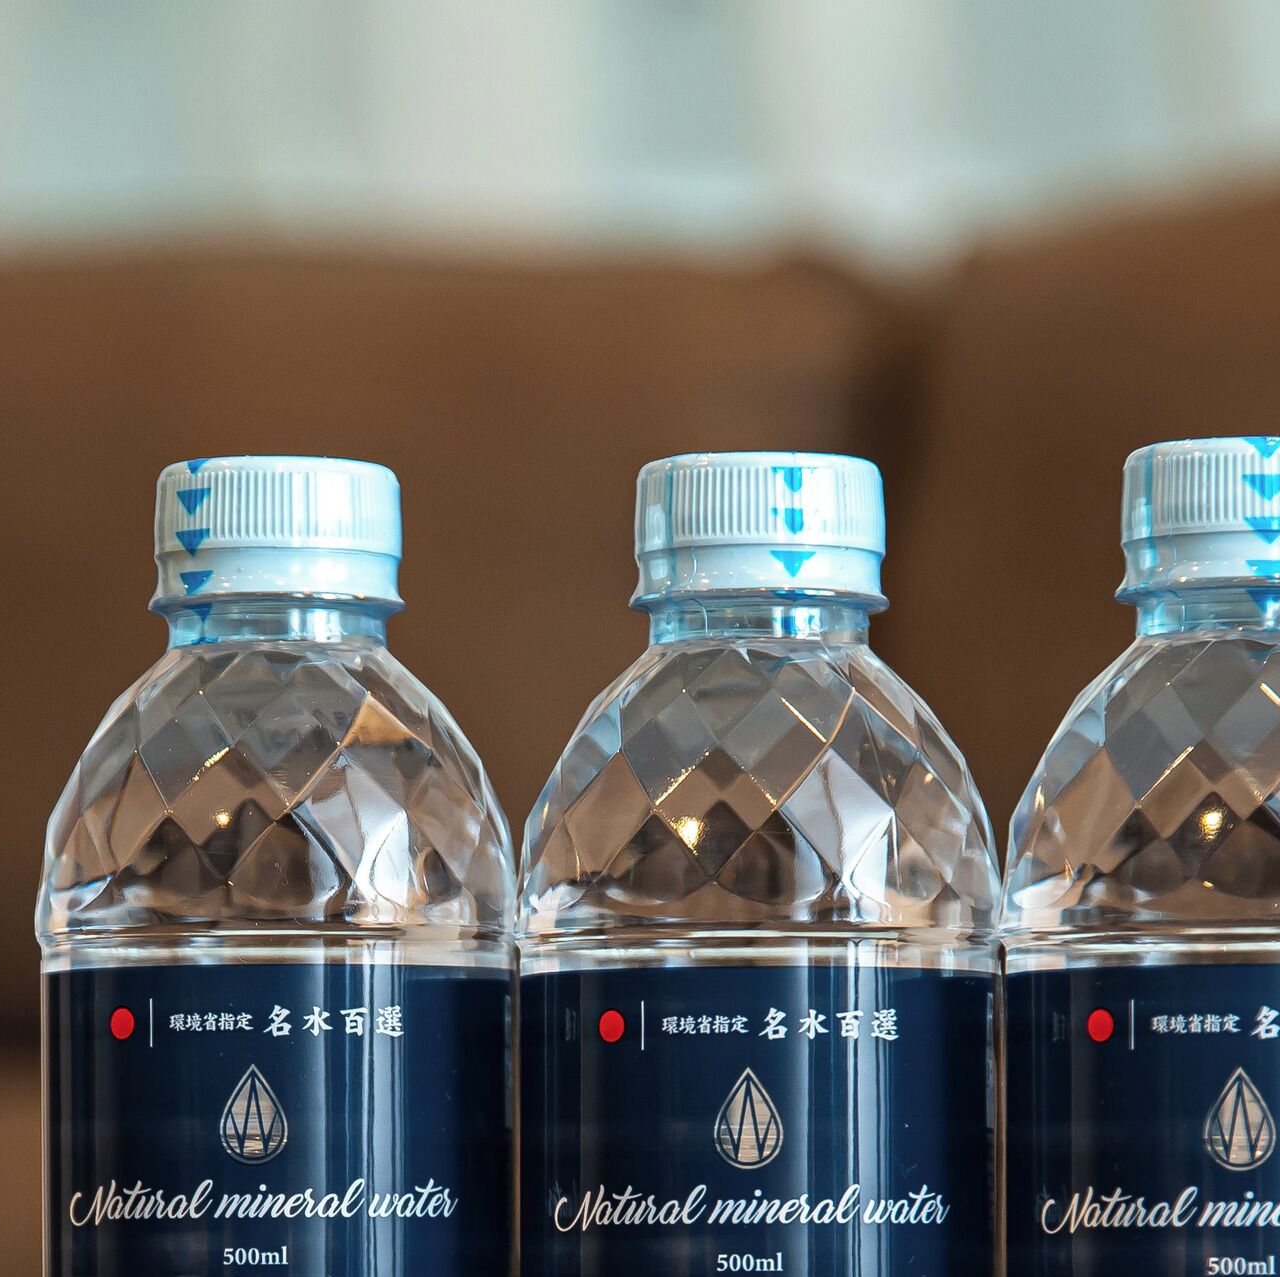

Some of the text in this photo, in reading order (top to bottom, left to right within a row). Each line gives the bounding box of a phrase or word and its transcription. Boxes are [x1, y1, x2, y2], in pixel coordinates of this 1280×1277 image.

[169, 1005, 406, 1038] 環境省指定 名水百選
[661, 1008, 900, 1041] 環境省指定 名水百選
[1151, 1013, 1241, 1034] 環境省指定
[69, 1178, 458, 1227] Natural mineral water
[554, 1184, 950, 1232] Natural mineral water
[1041, 1186, 1198, 1234] Natural
[222, 1246, 289, 1266] 500ml
[716, 1253, 784, 1272] 500ml
[1207, 1255, 1276, 1276] 500ml
